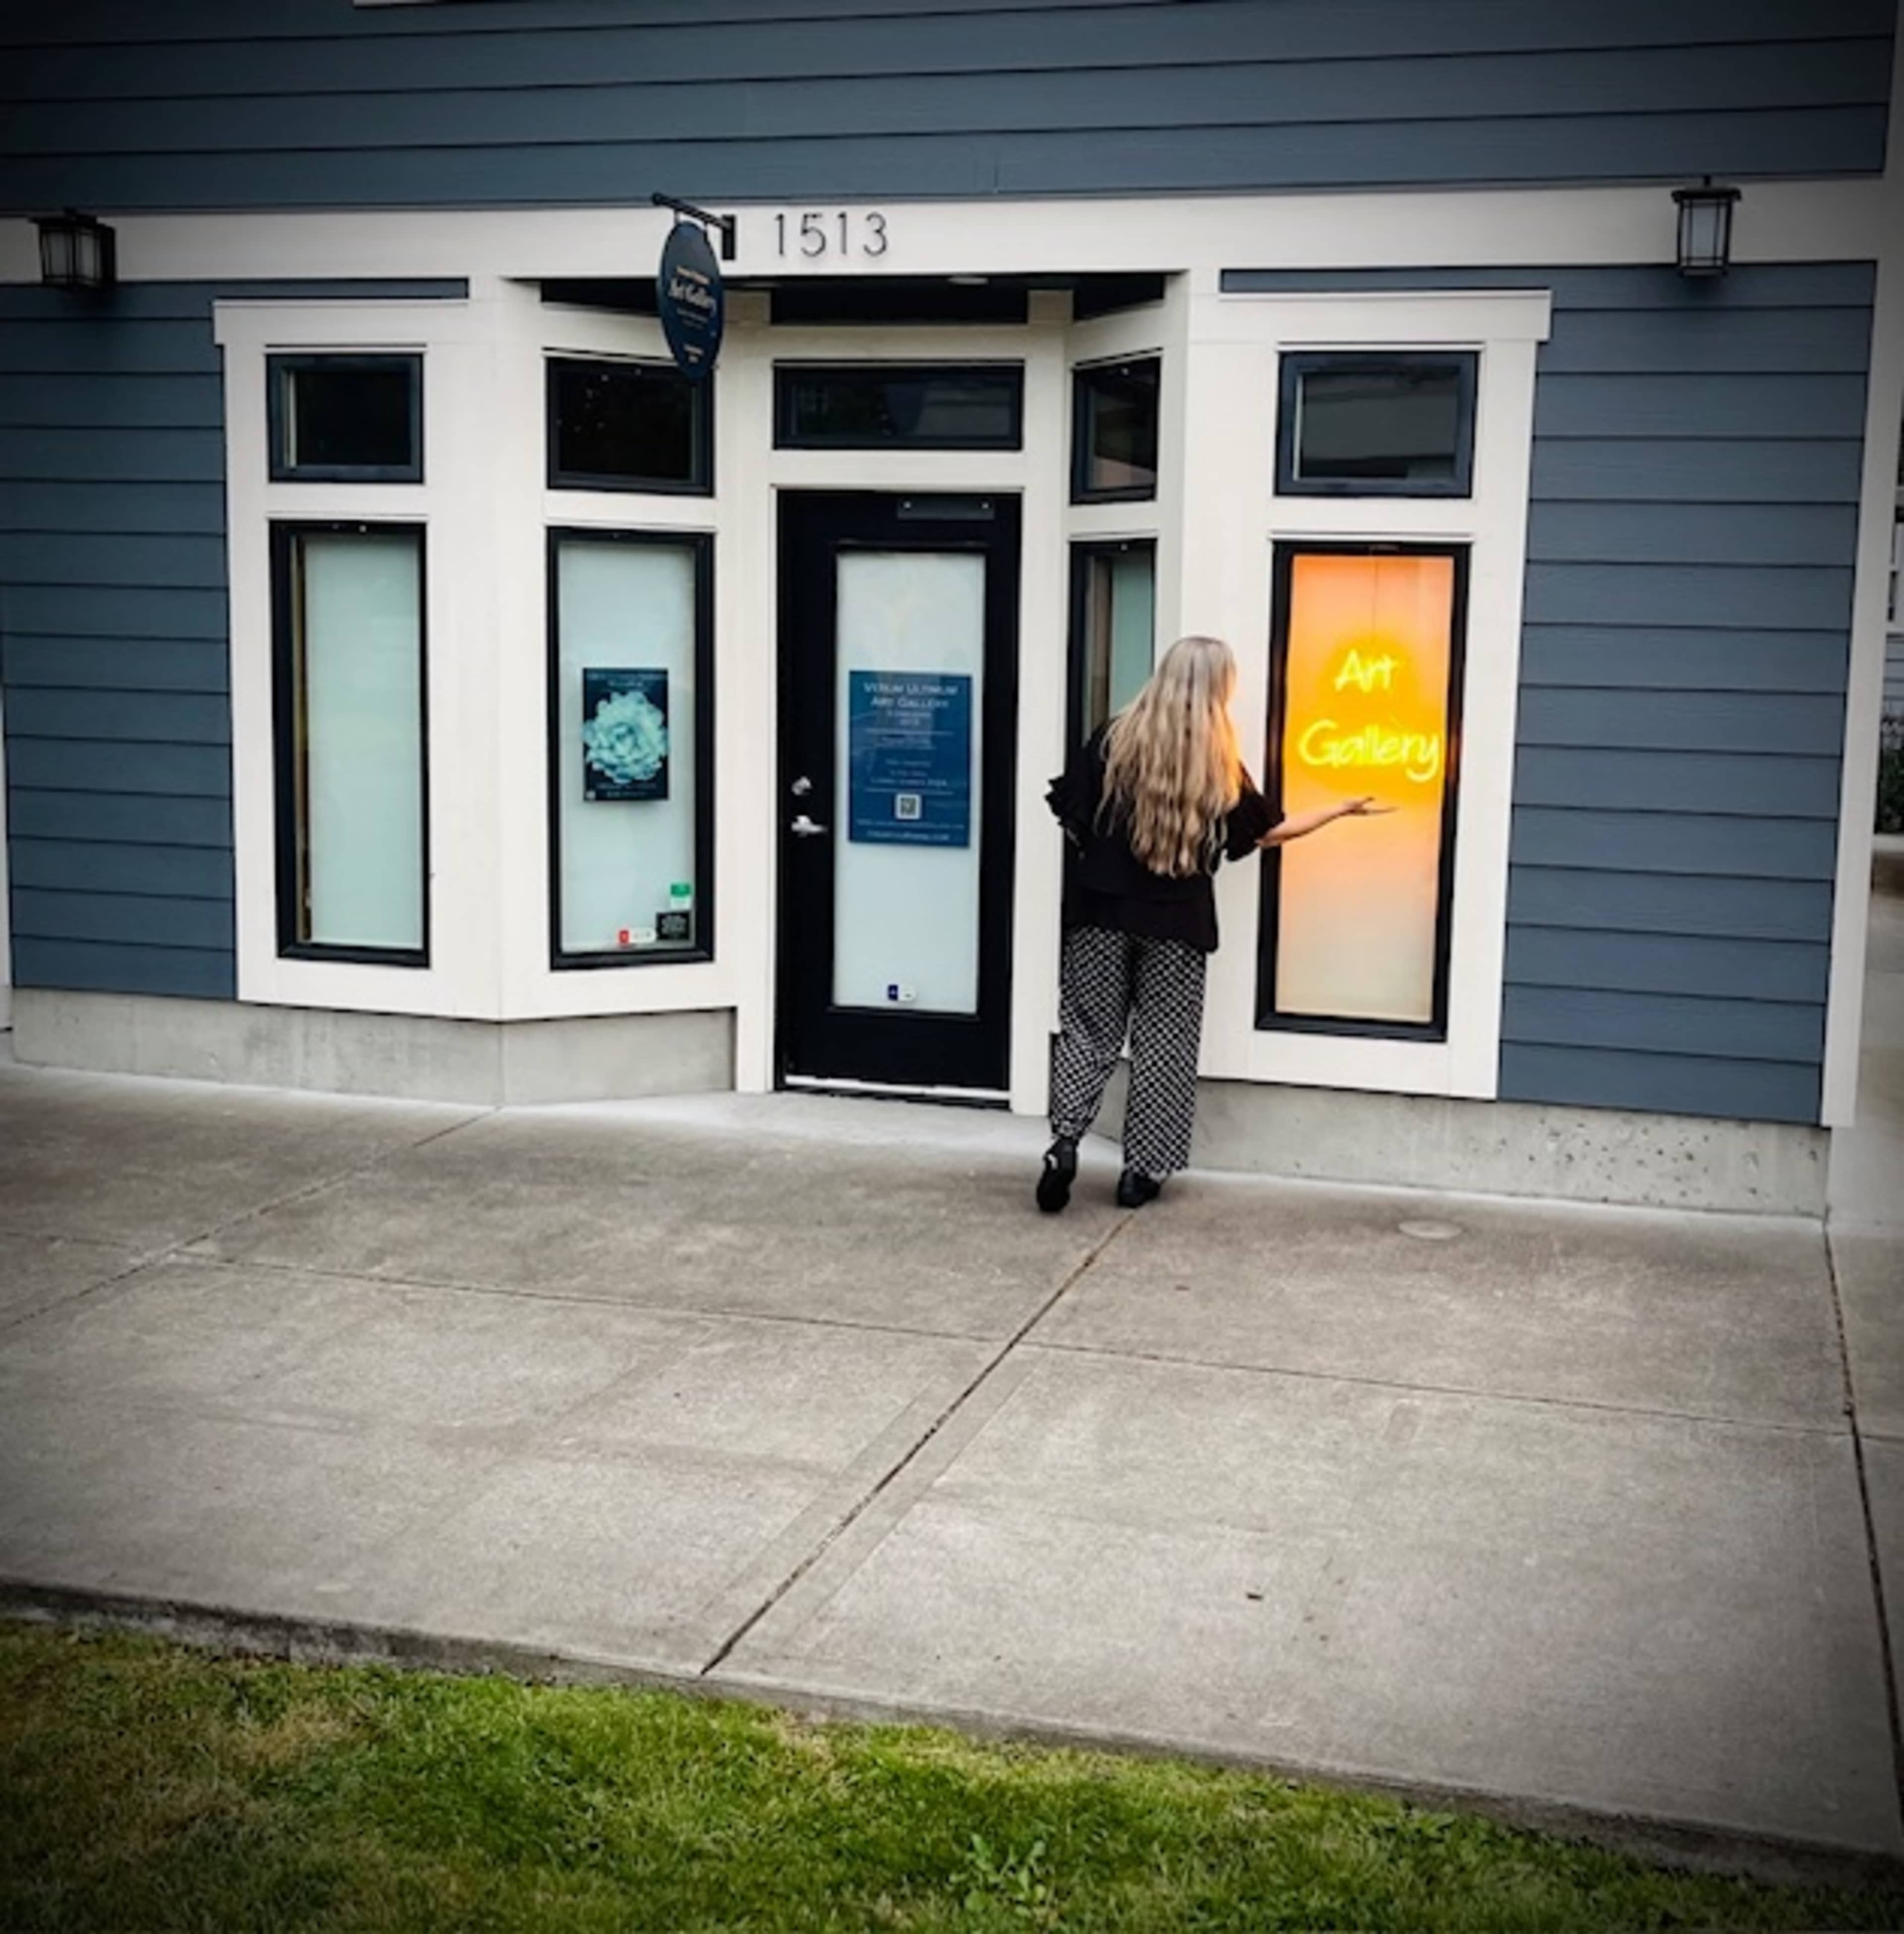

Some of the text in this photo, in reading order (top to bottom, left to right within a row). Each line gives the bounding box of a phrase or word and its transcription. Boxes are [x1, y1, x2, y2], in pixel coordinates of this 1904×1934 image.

[774, 212, 887, 256] 1513
[1334, 648, 1399, 693] Art
[1298, 719, 1439, 783] Gallery
